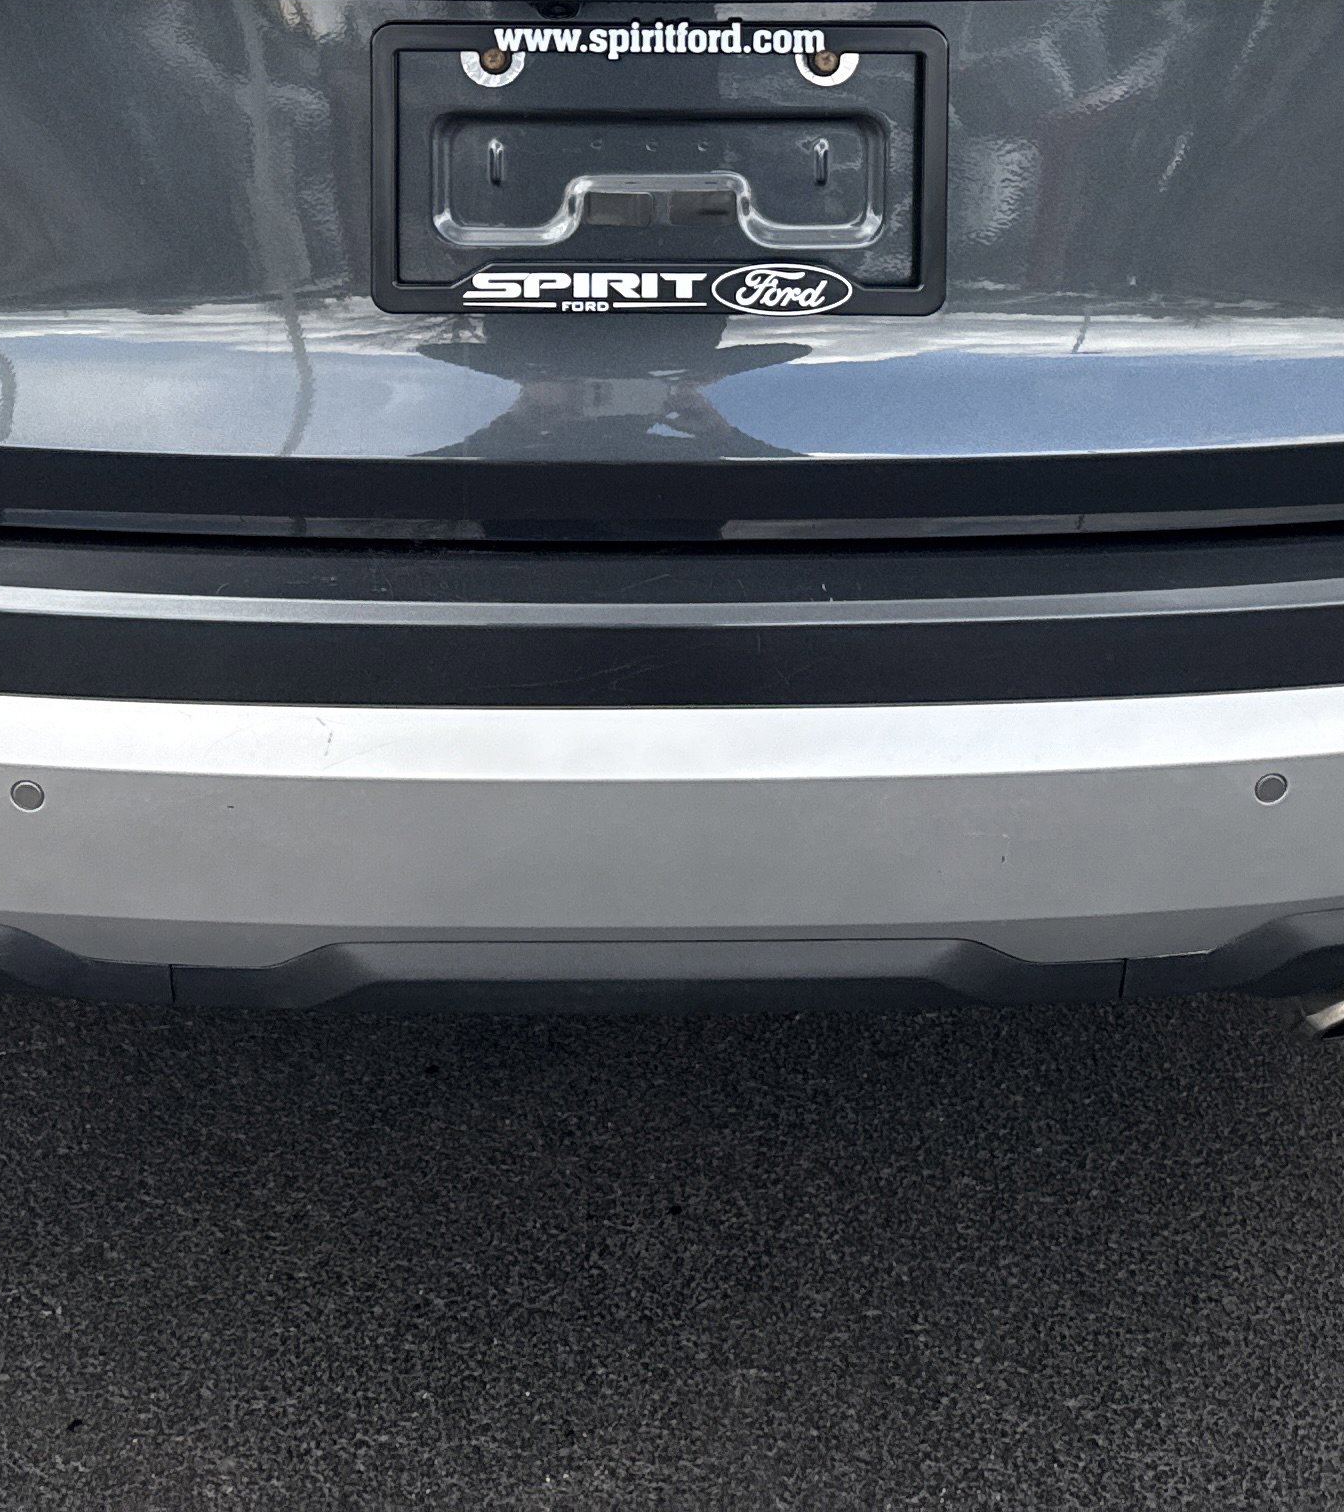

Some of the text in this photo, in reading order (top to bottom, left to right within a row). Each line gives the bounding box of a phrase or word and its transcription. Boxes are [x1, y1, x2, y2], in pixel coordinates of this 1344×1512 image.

[494, 21, 825, 60] www.spiritford.com
[463, 272, 707, 299] SPIRIT
[735, 269, 829, 308] Ford
[561, 301, 609, 312] FORD
